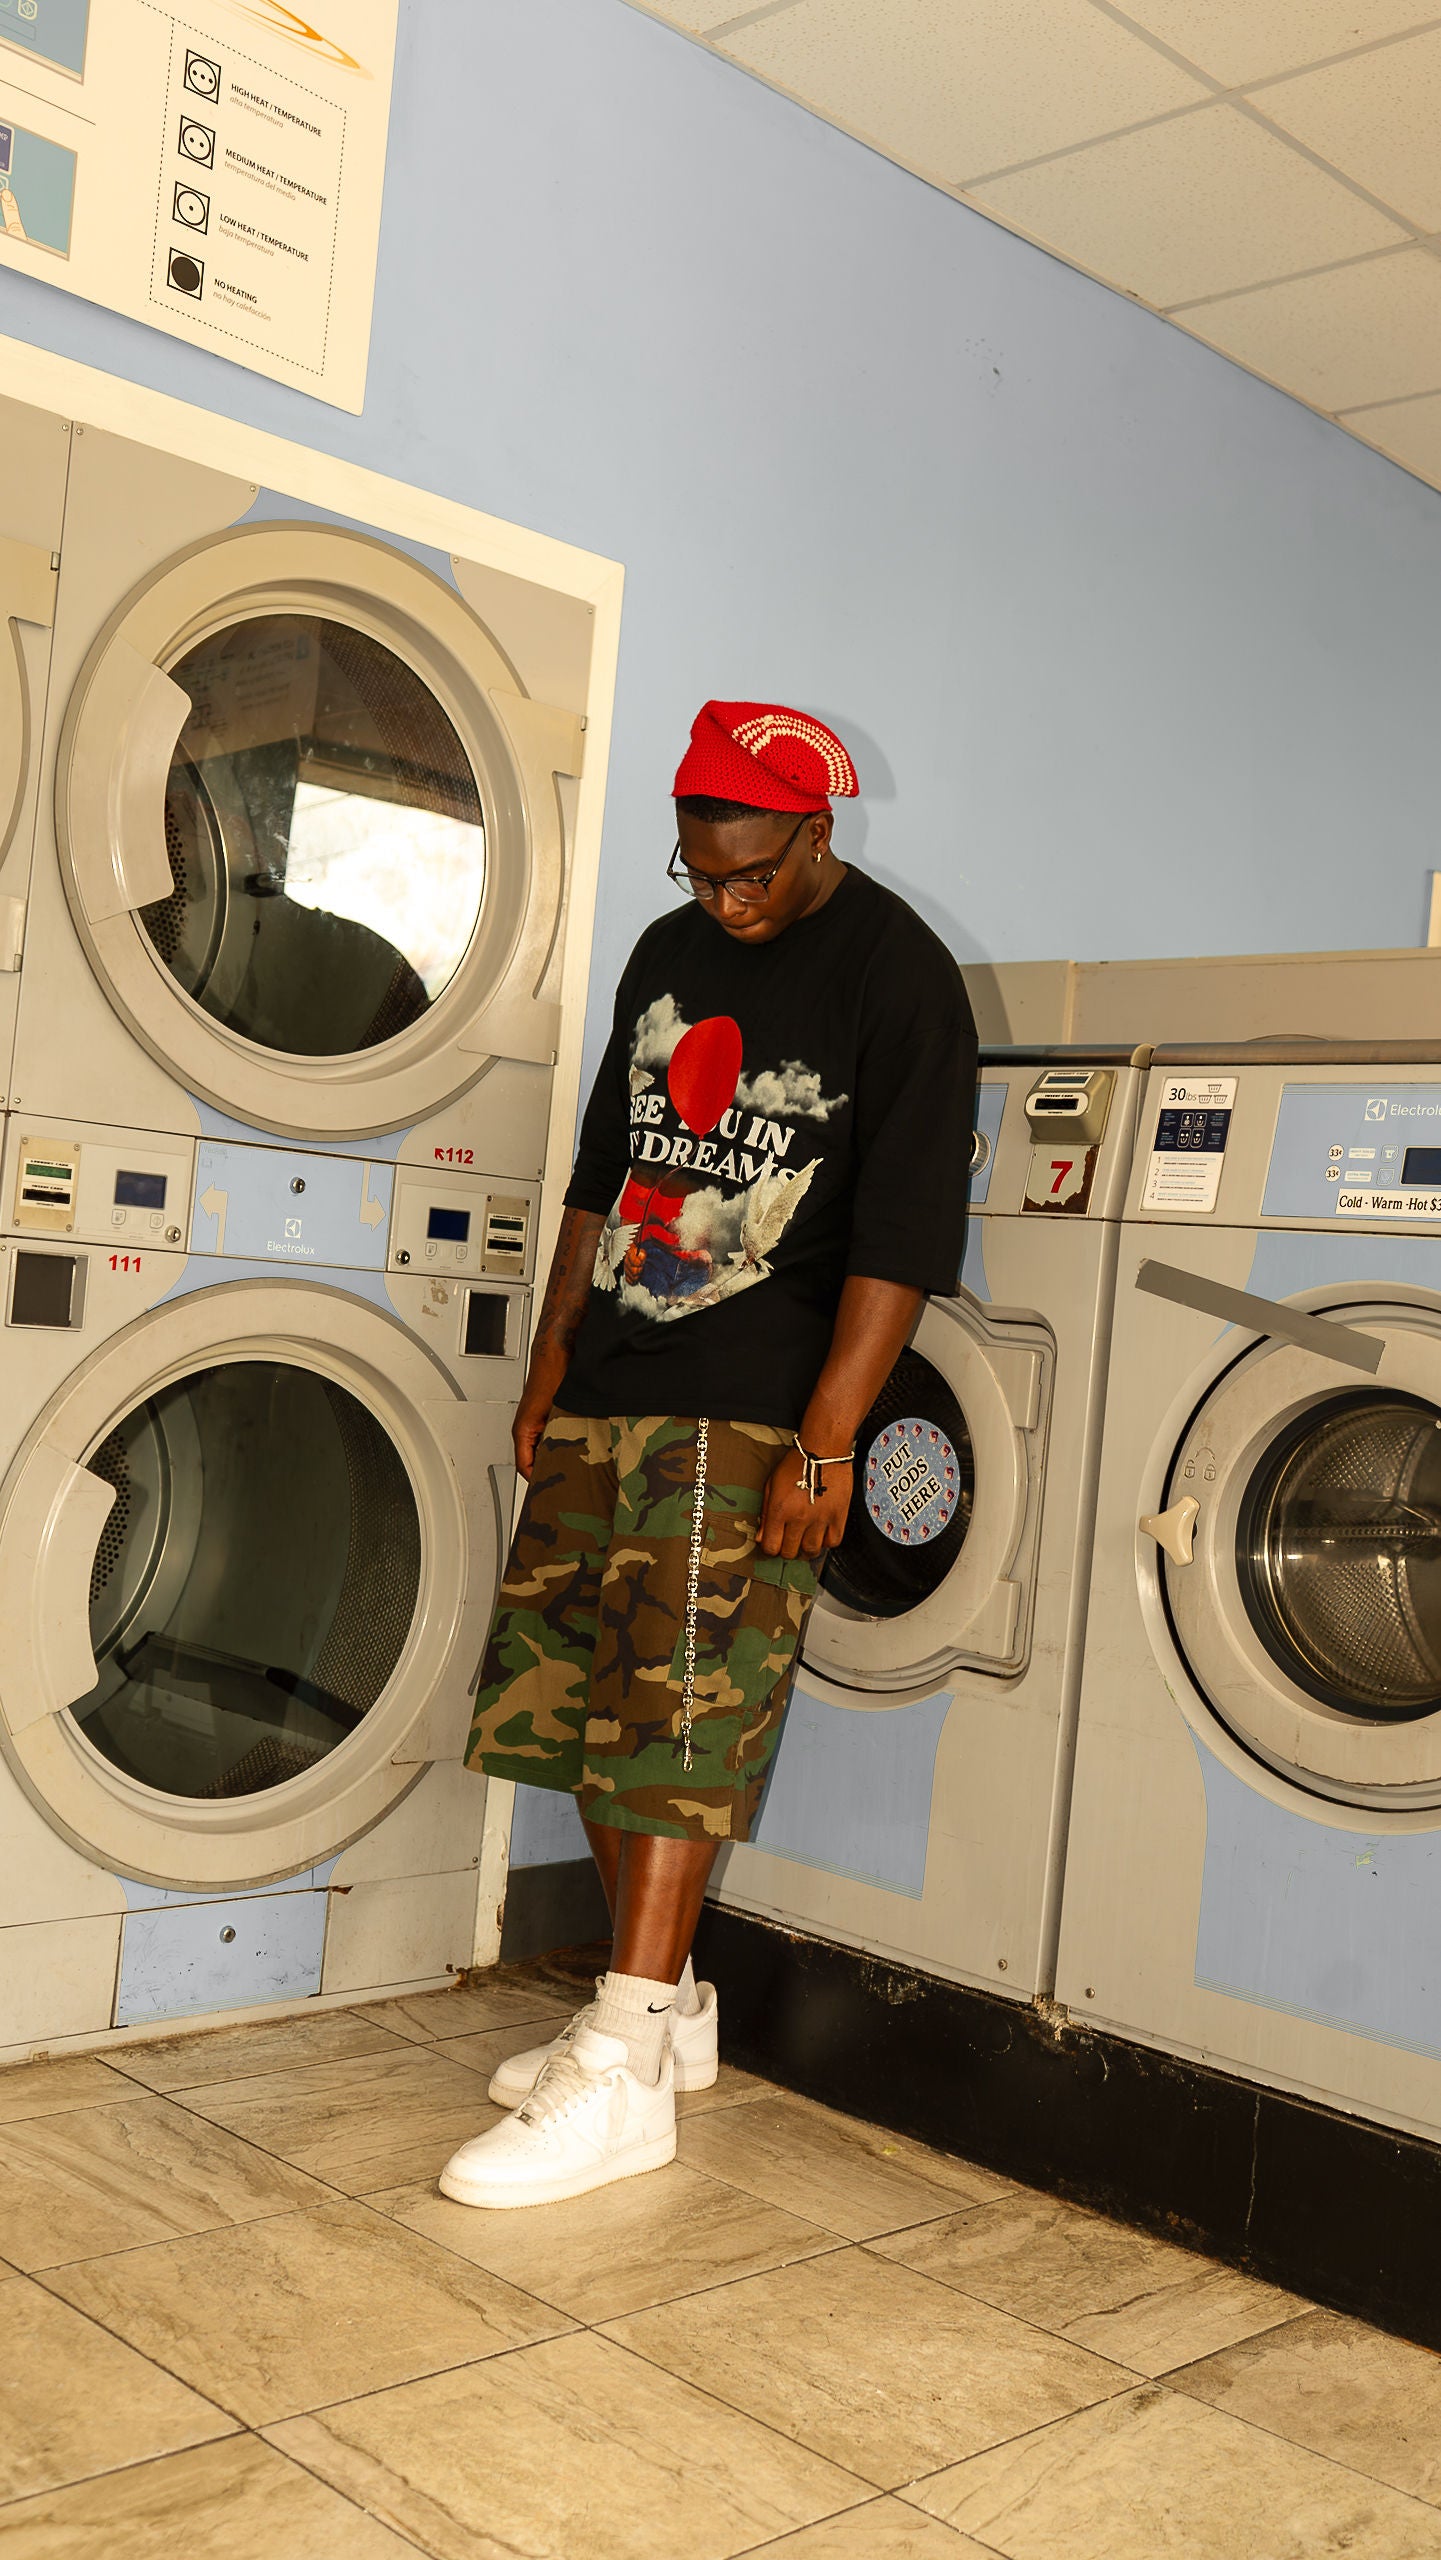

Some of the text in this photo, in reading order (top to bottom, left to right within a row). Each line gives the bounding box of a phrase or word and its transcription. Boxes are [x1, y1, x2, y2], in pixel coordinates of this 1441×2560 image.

[229, 96, 284, 128] alta temperatura
[231, 83, 249, 99] HIGH
[251, 94, 268, 108] HEAT
[274, 105, 322, 137] TEMPERATURE
[224, 161, 296, 201] temperatura del medio
[225, 148, 256, 169] MEDIUM
[256, 165, 275, 179] HEAT
[279, 175, 327, 206] TEMPERATURE
[218, 226, 275, 257] baja temperatura
[220, 213, 236, 227] LOW
[237, 221, 255, 236] HEAT
[260, 232, 309, 262] TEMPERATURE
[213, 290, 272, 322] no hay calefacción
[214, 278, 258, 304] NO HEATING
[1390, 1103, 1441, 1117] Electrol
[743, 1116, 796, 1157] IN
[445, 1147, 474, 1165] 112
[1050, 1160, 1074, 1194] 7
[1339, 1195, 1363, 1208] Cold
[1371, 1196, 1403, 1210] Warm
[108, 1254, 141, 1273] 111
[266, 1240, 316, 1255] Electrolux
[882, 1443, 911, 1479] PUT
[889, 1458, 928, 1502] PODS
[900, 1476, 941, 1522] HERE
